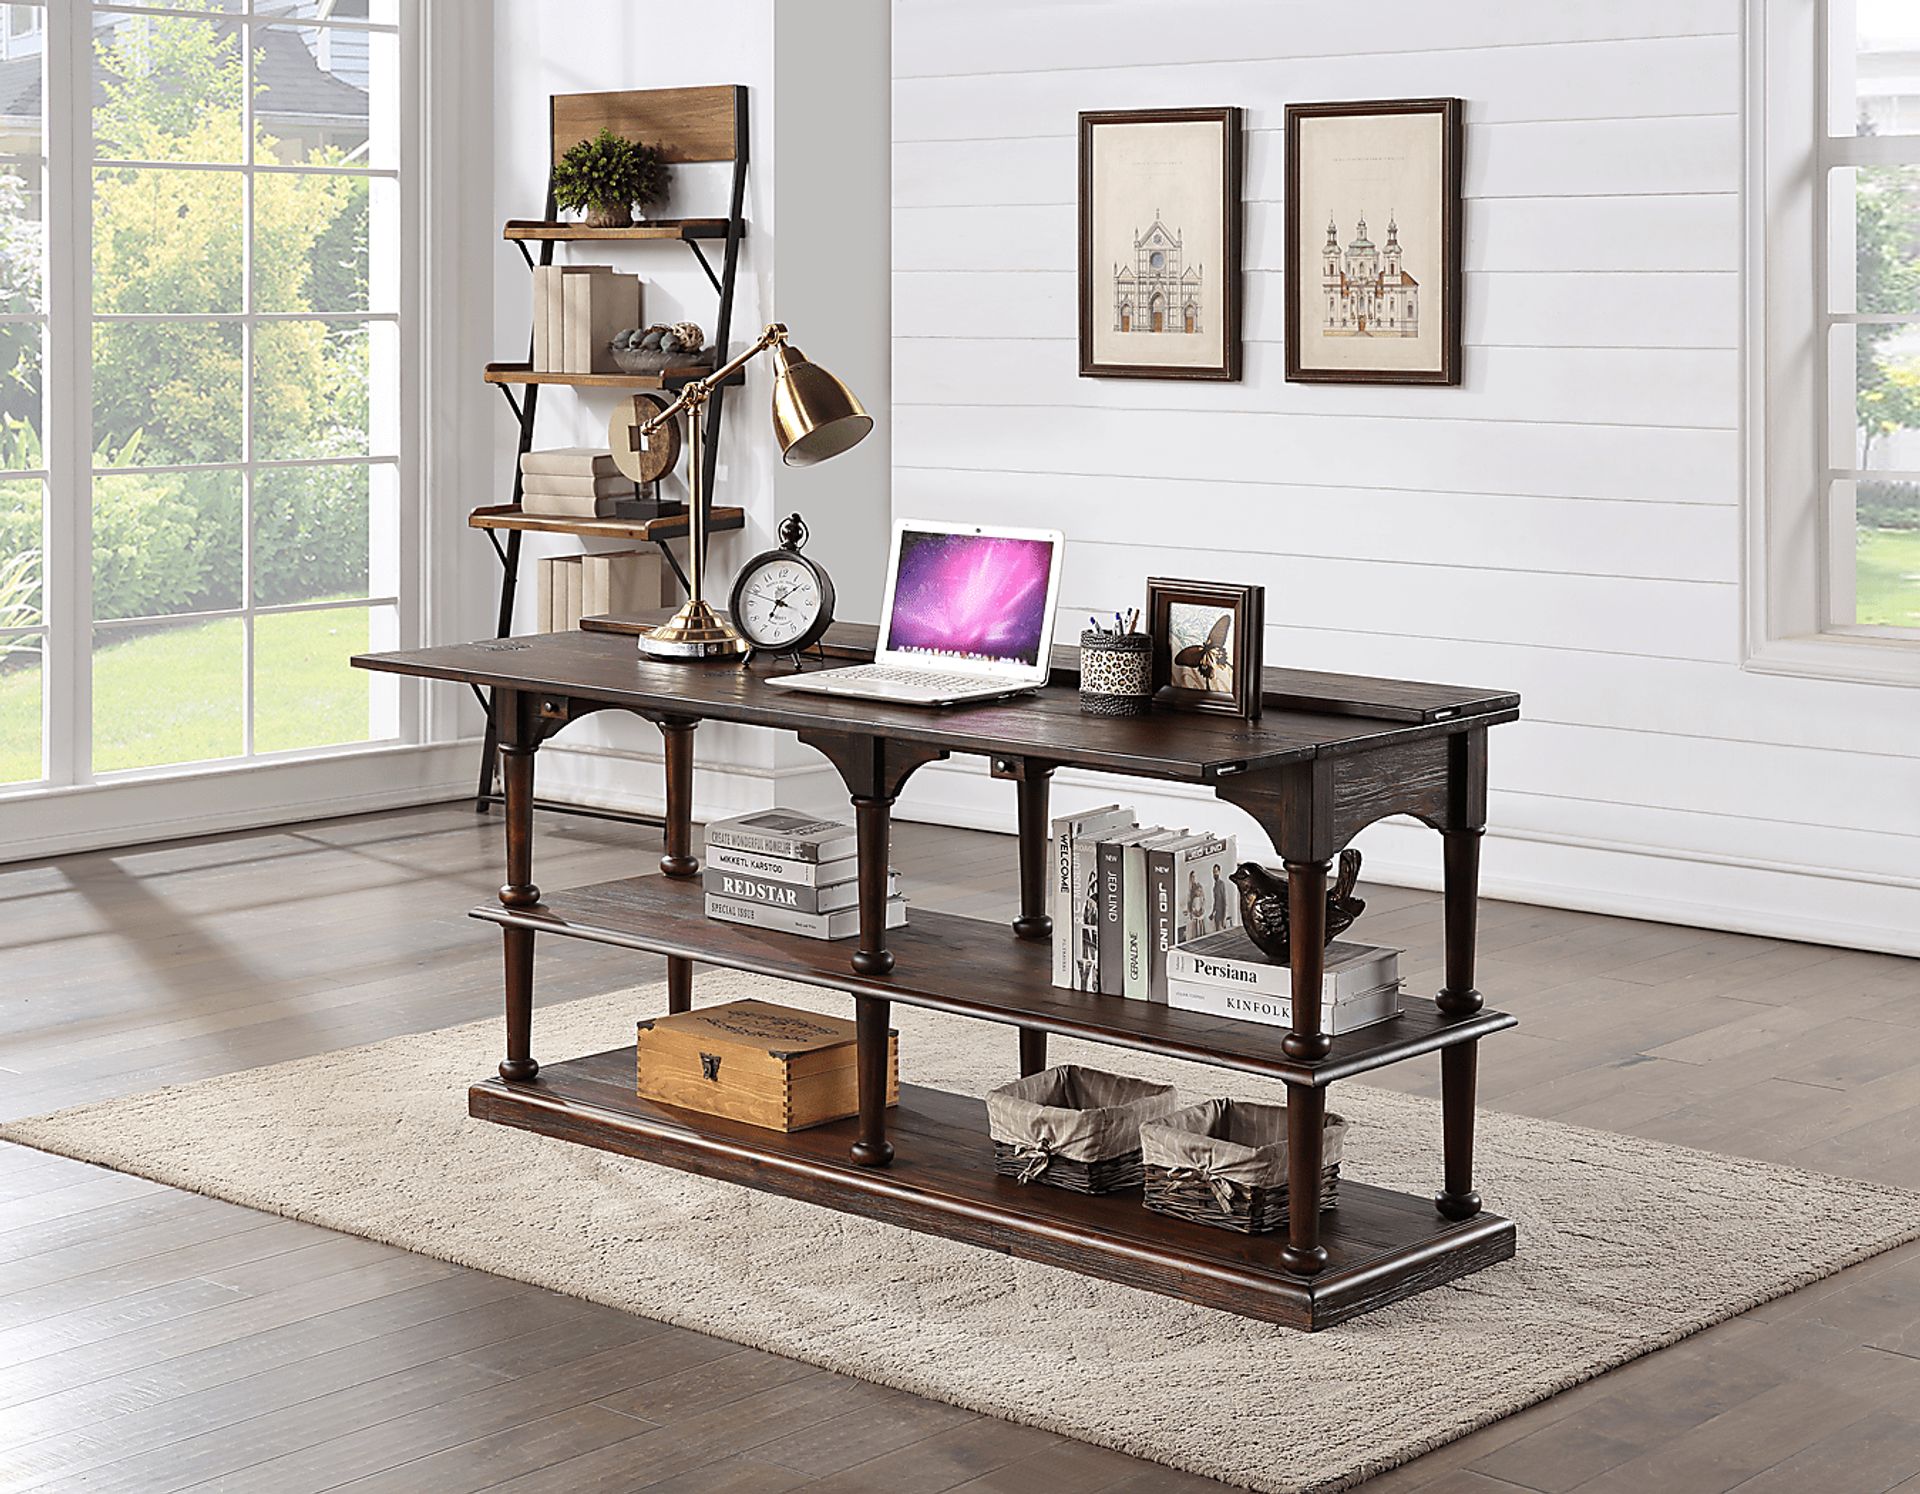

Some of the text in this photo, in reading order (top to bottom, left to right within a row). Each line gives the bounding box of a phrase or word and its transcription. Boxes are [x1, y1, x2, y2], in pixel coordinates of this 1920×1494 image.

[711, 831, 730, 845] CREATE
[732, 834, 764, 850] WONDERFUL
[1205, 843, 1223, 855] LIND
[1060, 833, 1069, 894] WELCOME
[1154, 865, 1170, 874] NEW
[723, 877, 798, 906] REDSTAR
[1107, 870, 1118, 922] JED LIND
[712, 902, 754, 919] SPECIAL ISSUE
[1159, 882, 1169, 952] JED LIND
[1129, 930, 1139, 980] GERALDINE
[1194, 958, 1258, 984] Persiana
[1226, 997, 1291, 1019] KINFOLK
